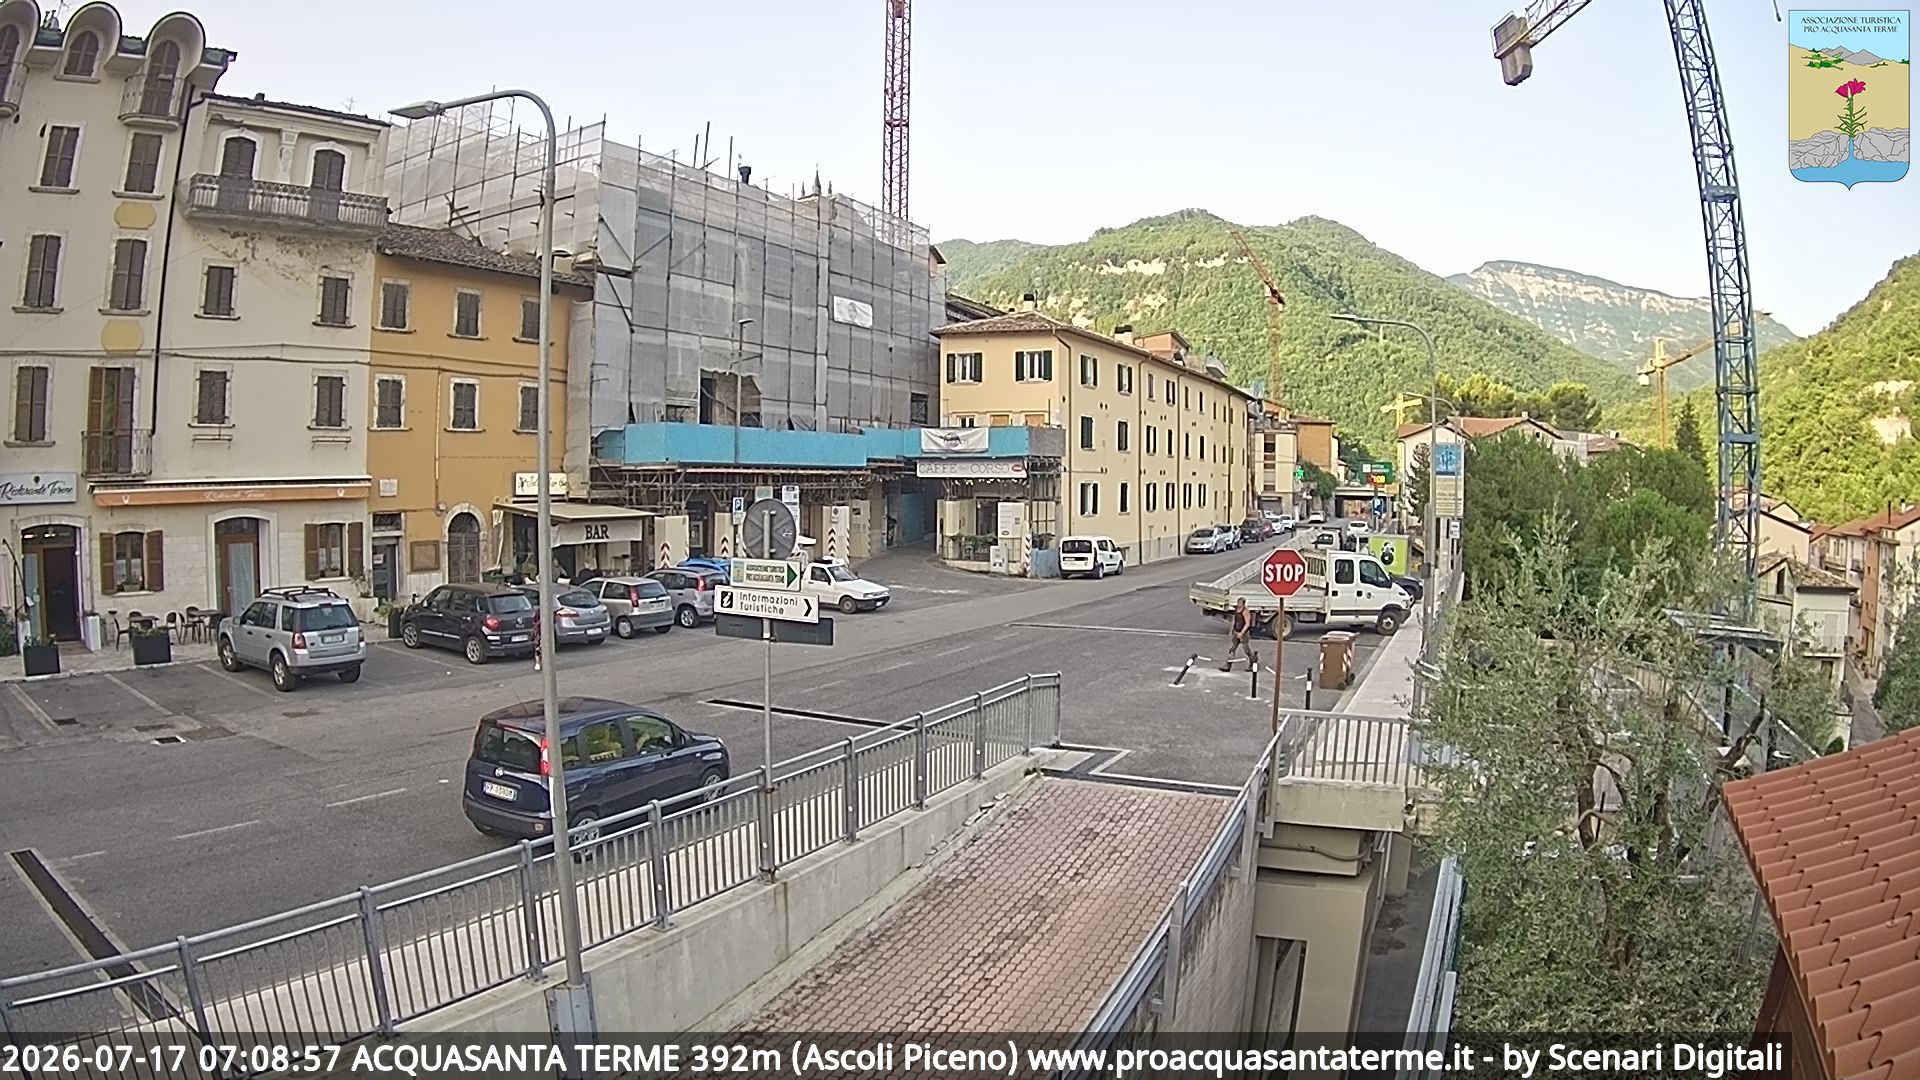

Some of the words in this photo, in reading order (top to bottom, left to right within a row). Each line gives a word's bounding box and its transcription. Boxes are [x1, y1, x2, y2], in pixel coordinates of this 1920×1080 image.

[970, 463, 1010, 474] CORSO
[584, 524, 610, 541] BAR
[1265, 563, 1304, 582] STOP
[740, 591, 798, 606] Informazioni
[740, 601, 784, 615] Turistiche
